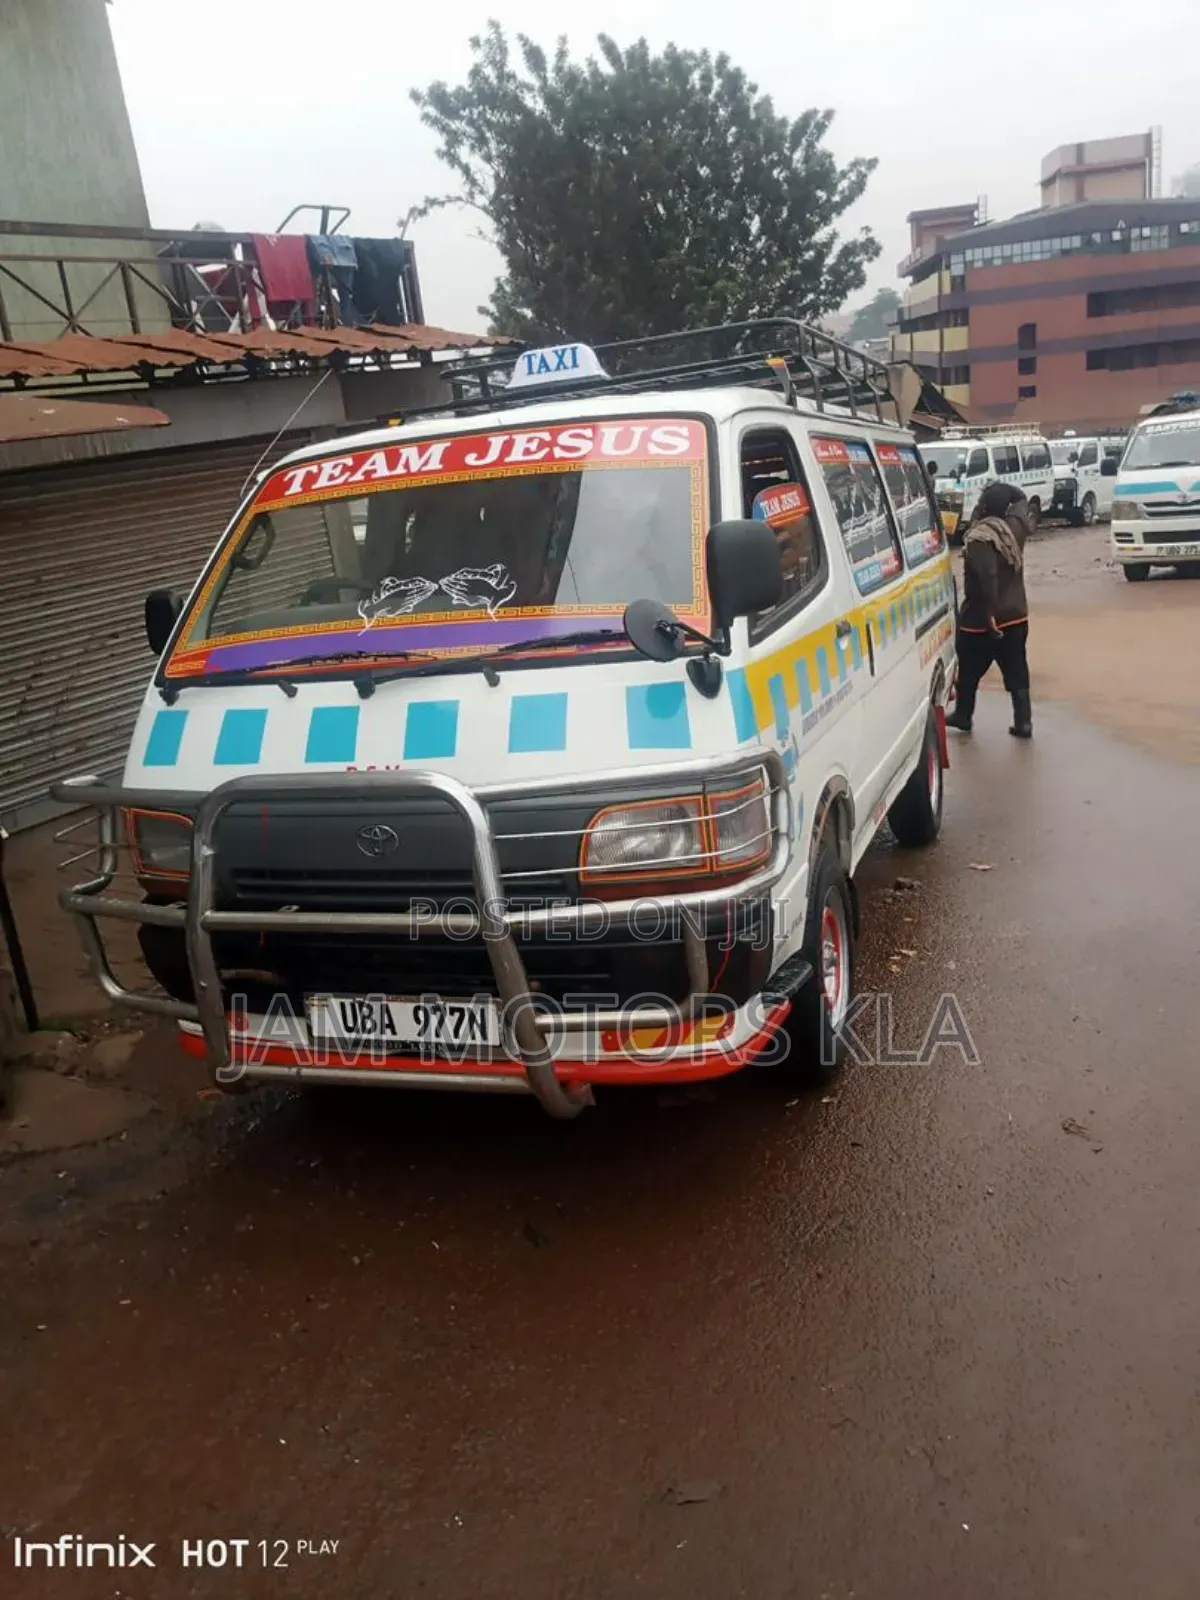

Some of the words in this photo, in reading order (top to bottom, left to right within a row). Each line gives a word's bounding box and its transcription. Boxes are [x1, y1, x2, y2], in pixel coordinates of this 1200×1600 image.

[523, 345, 581, 376] TAXI
[283, 443, 449, 496] TEAM
[464, 426, 691, 468] JESUS
[339, 1000, 397, 1036] UBA
